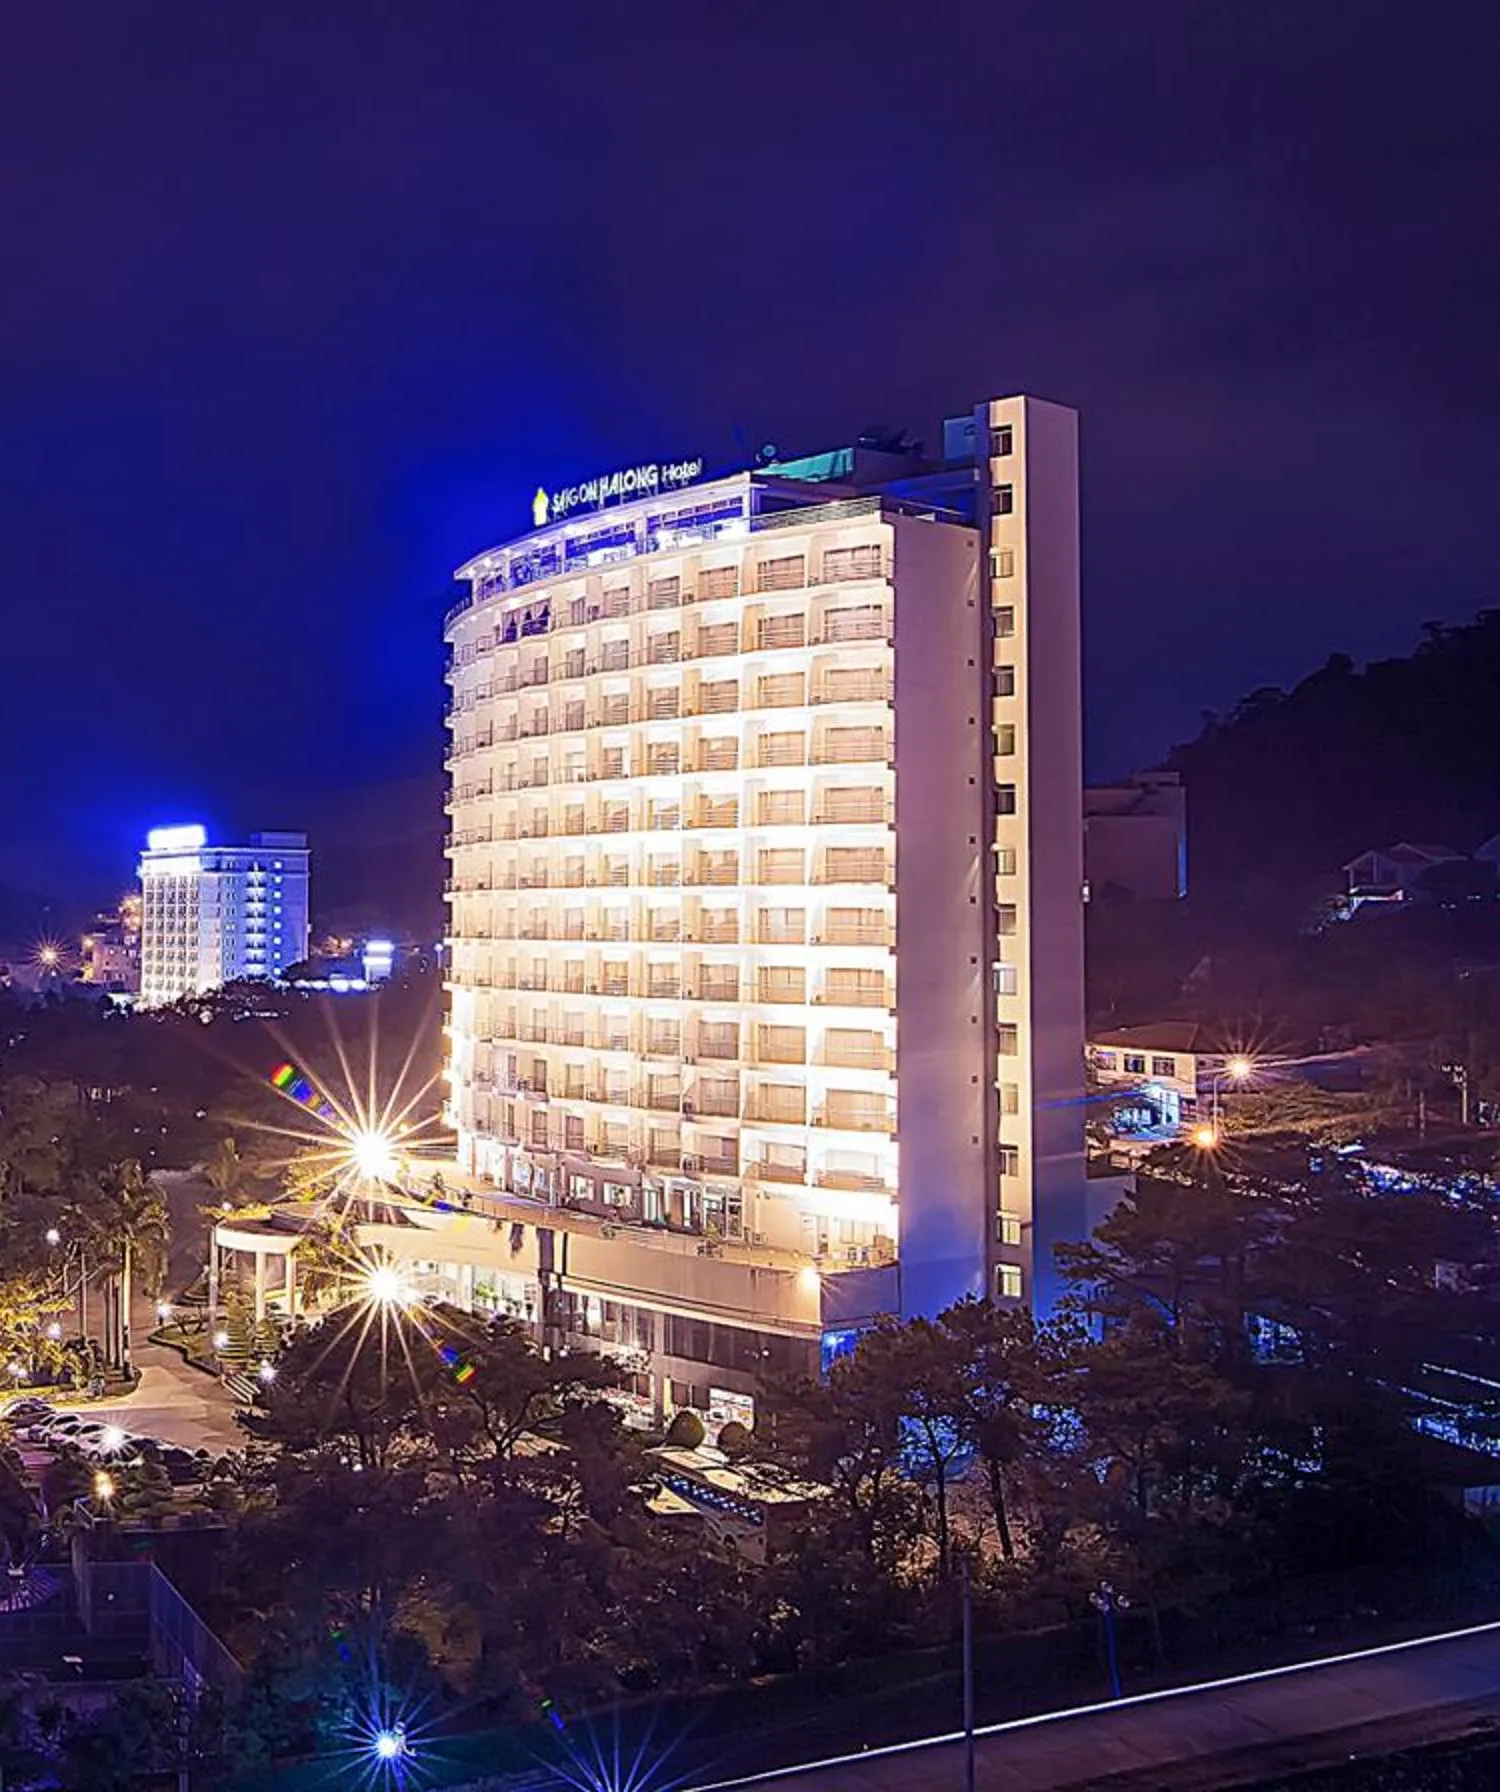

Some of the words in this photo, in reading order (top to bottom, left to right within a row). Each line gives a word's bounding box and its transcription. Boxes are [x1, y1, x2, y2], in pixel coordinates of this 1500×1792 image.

[551, 479, 597, 513] SAIGON
[599, 464, 659, 498] HALONG
[661, 457, 703, 483] Hotel
